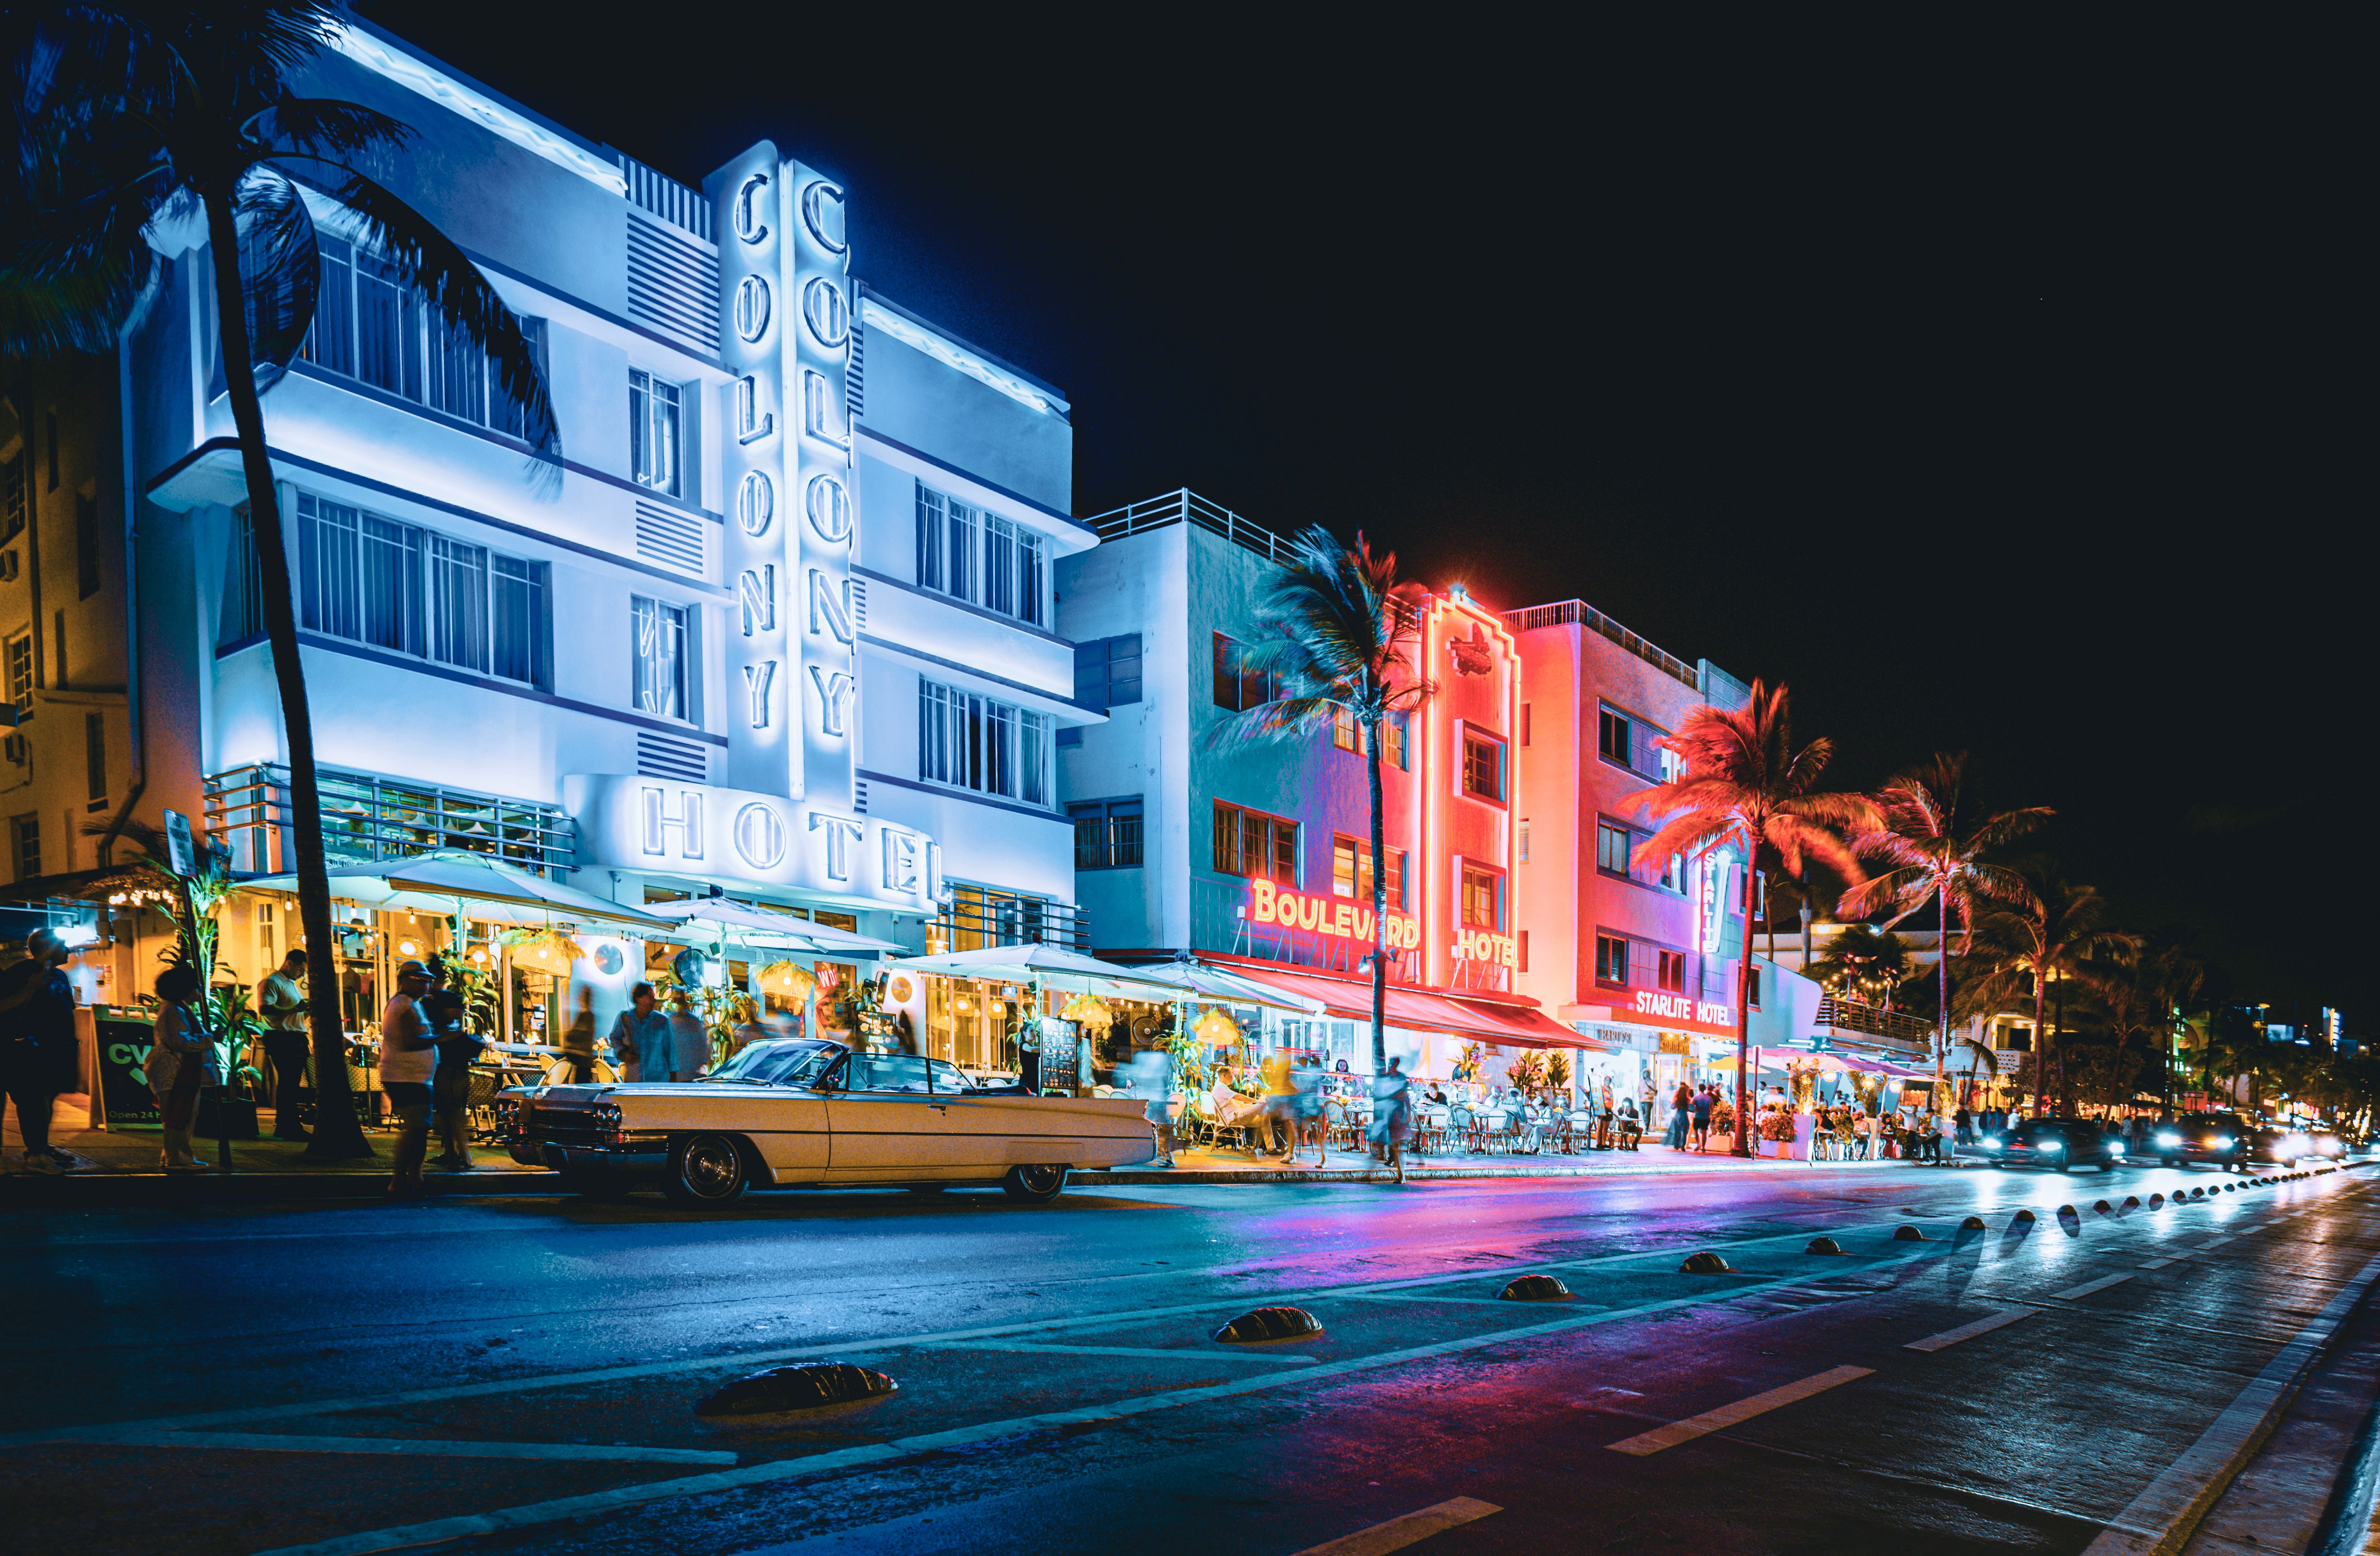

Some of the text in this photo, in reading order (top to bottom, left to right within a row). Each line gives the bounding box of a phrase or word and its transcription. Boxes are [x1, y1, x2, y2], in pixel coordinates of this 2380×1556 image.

[733, 173, 777, 729] COLONY
[802, 181, 854, 737] COLONY
[641, 786, 952, 902] HOTEL
[1703, 852, 1716, 953] STARLITE
[1459, 928, 1519, 968] HOTEL
[1636, 991, 1731, 1026] STARLITE HOTEL
[108, 1043, 153, 1064] CV
[109, 1111, 138, 1119] Open
